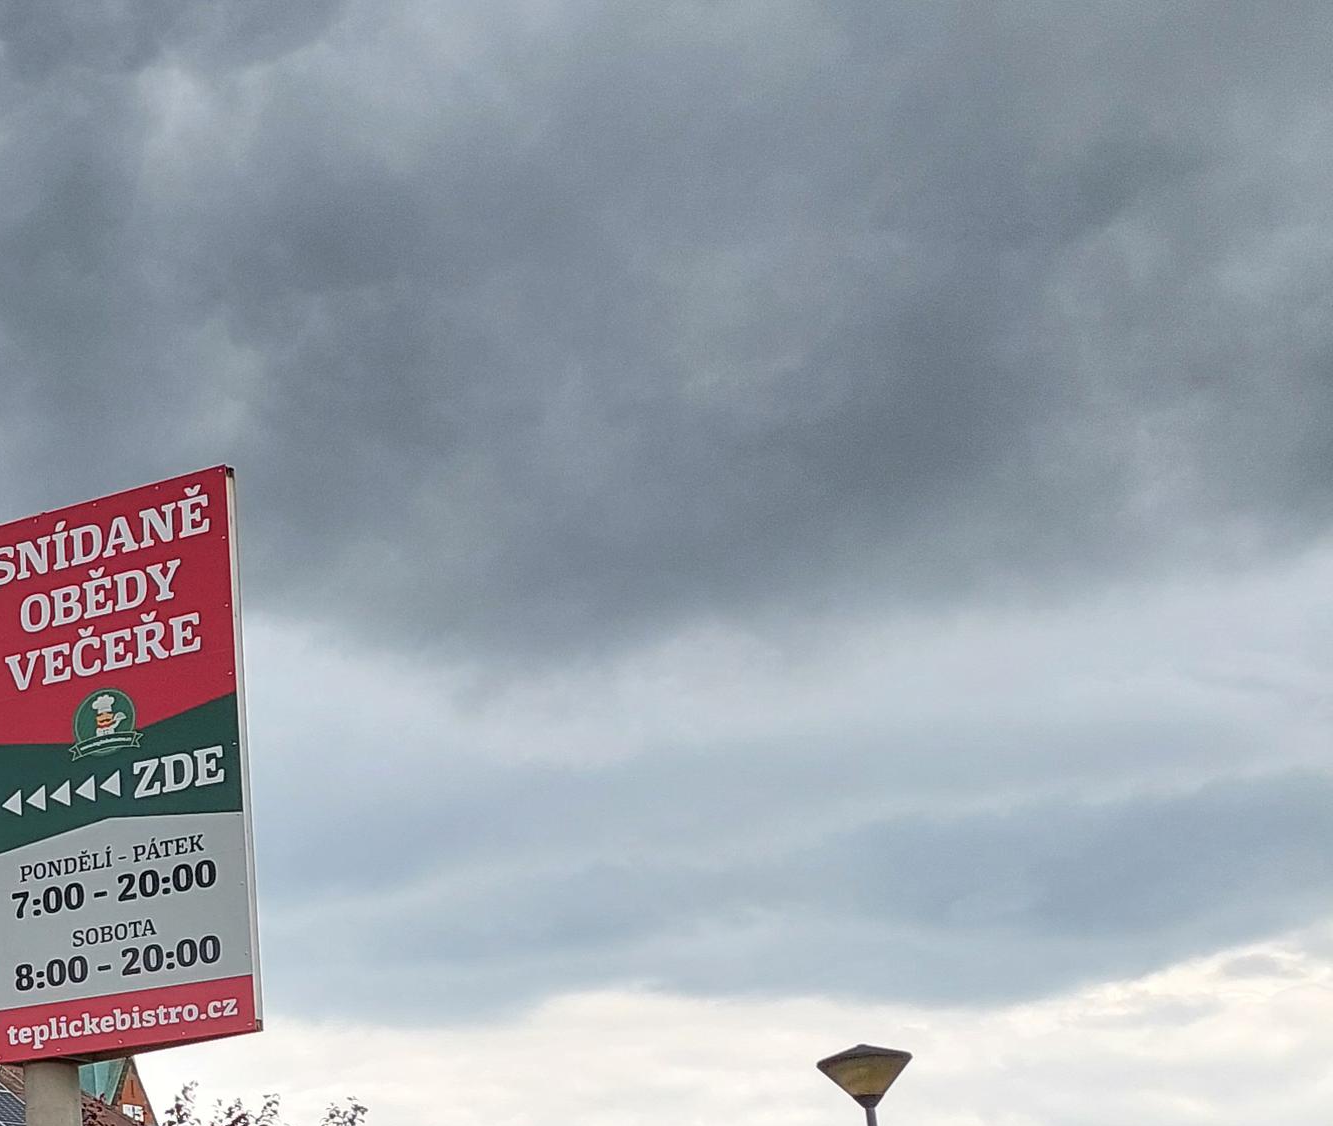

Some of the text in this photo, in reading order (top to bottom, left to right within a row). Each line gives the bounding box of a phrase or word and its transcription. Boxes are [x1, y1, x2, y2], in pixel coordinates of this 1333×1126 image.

[20, 559, 181, 633] OBĚDY
[5, 610, 201, 691] VEČEŘE
[133, 745, 225, 799] ZDE
[19, 846, 113, 882] PONDĚLÍ
[133, 834, 204, 863] PÁTEK
[11, 882, 85, 919] 7:00
[117, 859, 217, 902] 20:00
[72, 918, 158, 947] SOBOTA
[14, 955, 89, 992] 8:00
[120, 934, 222, 977] 20:00
[6, 998, 239, 1049] teplickebistro.cz
